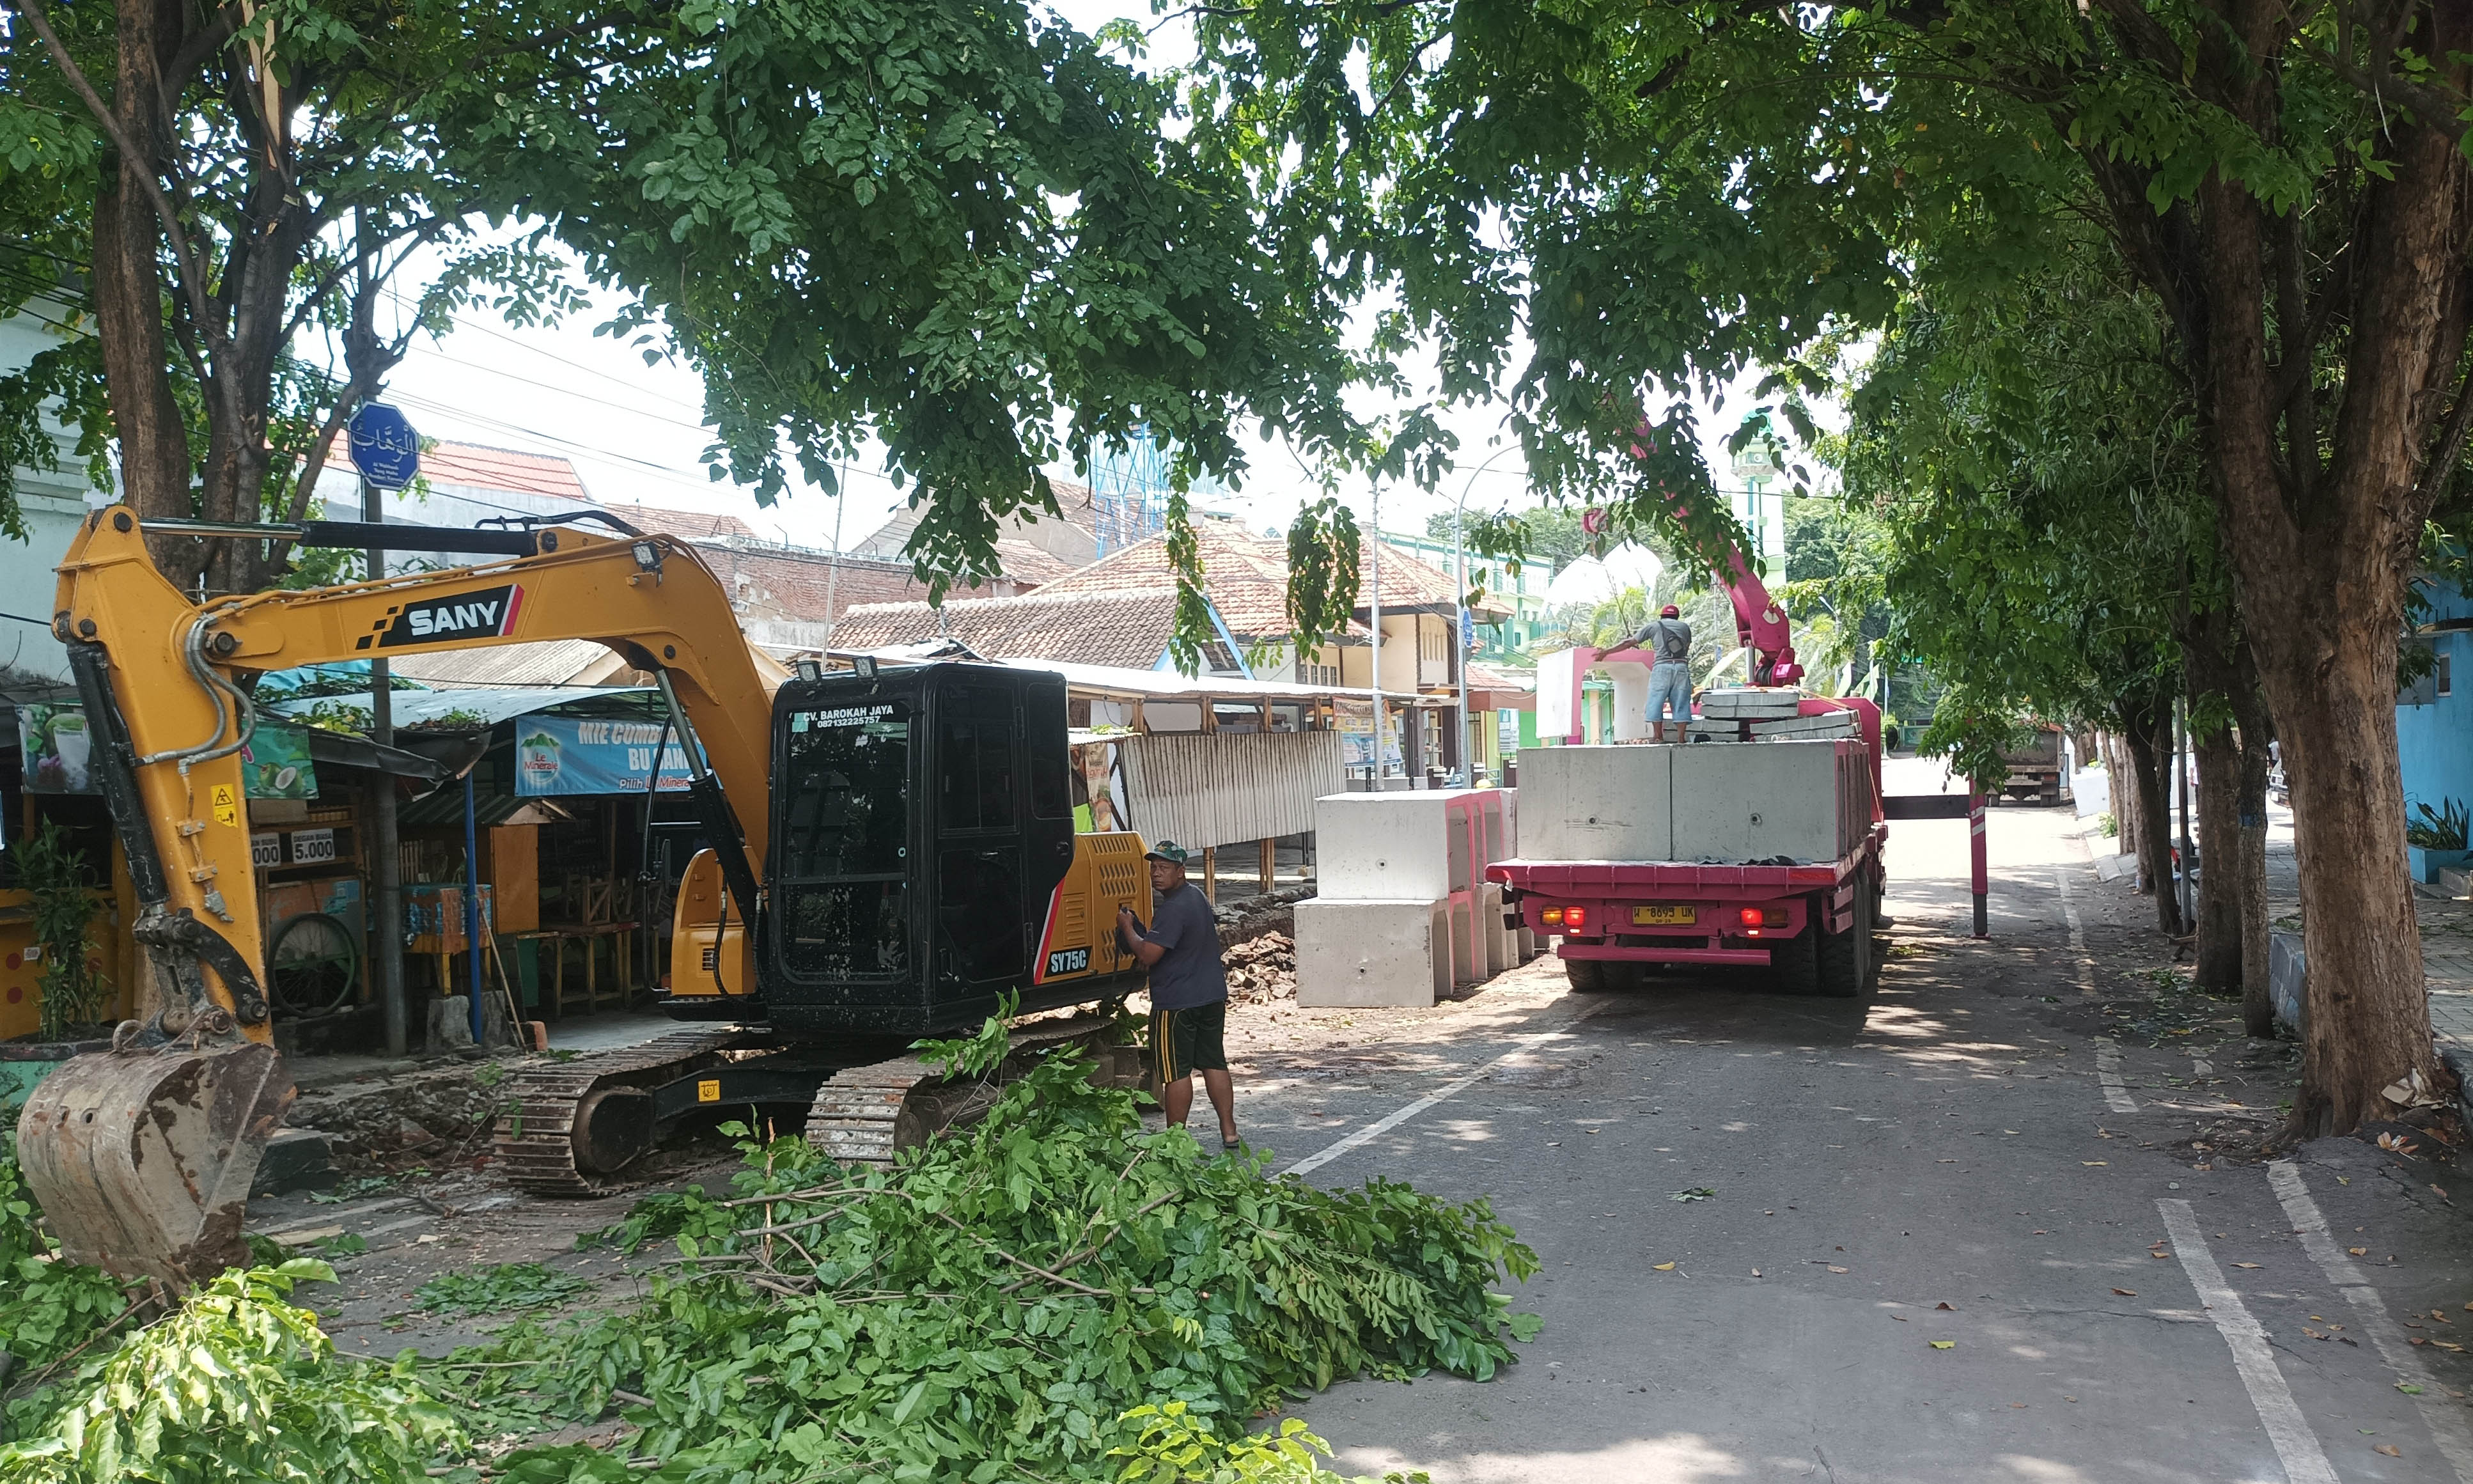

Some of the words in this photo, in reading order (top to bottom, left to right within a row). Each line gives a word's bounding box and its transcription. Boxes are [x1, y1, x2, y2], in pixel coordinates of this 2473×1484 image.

[409, 601, 499, 636] SANY
[803, 712, 818, 722] CV.
[820, 707, 867, 720] BAROKAH
[869, 705, 893, 715] JAYA
[817, 715, 880, 728] 082132225757
[578, 721, 609, 745] MIE
[524, 761, 558, 770] Minerale
[535, 752, 546, 762] Le
[628, 747, 650, 770] BU
[619, 777, 643, 790] Pilih
[659, 776, 690, 788] Minera
[295, 840, 333, 860] 5.000
[1633, 907, 1640, 918] W
[1681, 907, 1694, 918] UK
[1050, 949, 1086, 972] SY75C
